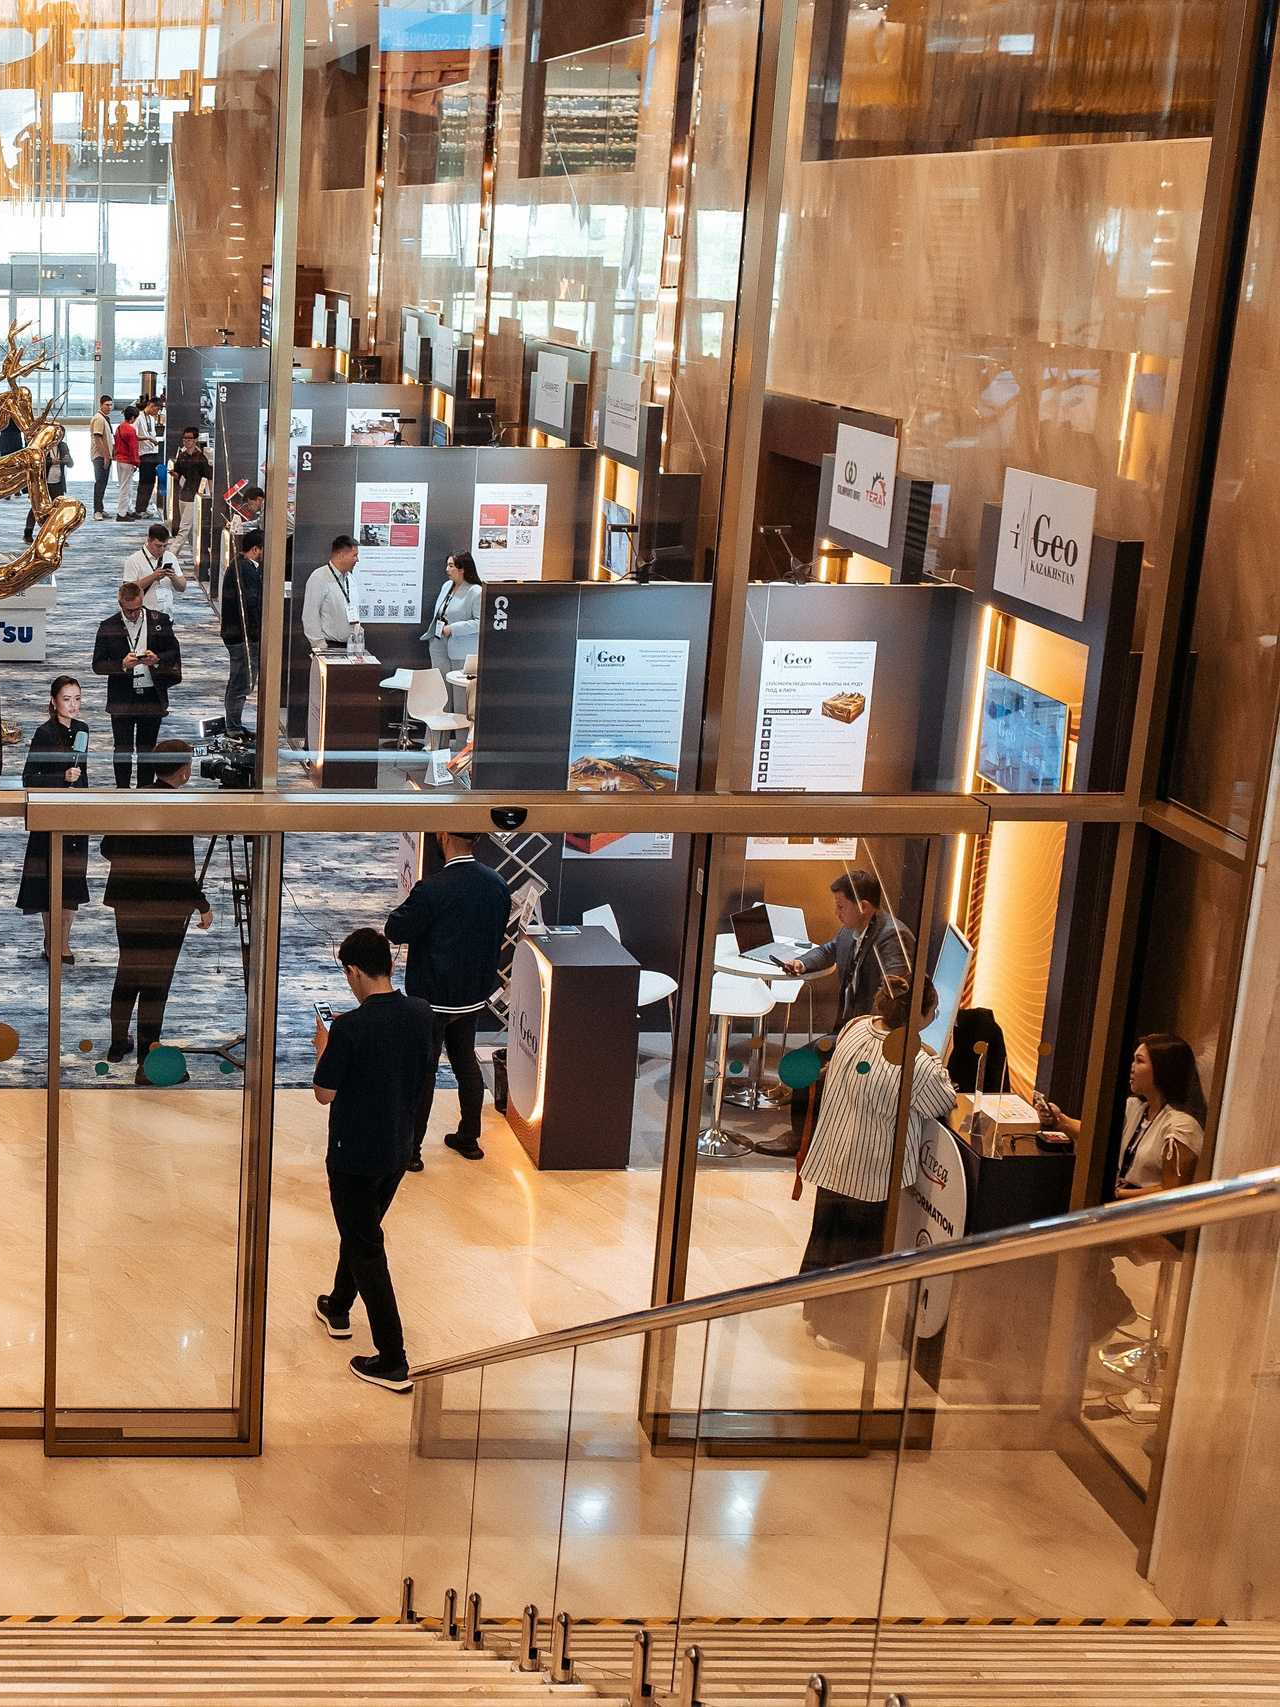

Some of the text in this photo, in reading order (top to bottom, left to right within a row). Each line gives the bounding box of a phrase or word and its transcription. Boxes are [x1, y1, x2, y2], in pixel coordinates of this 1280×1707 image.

[302, 451, 312, 471] C41
[865, 490, 883, 506] TERA
[1030, 560, 1075, 586] KAZAKHSTAN
[493, 596, 509, 630] C43
